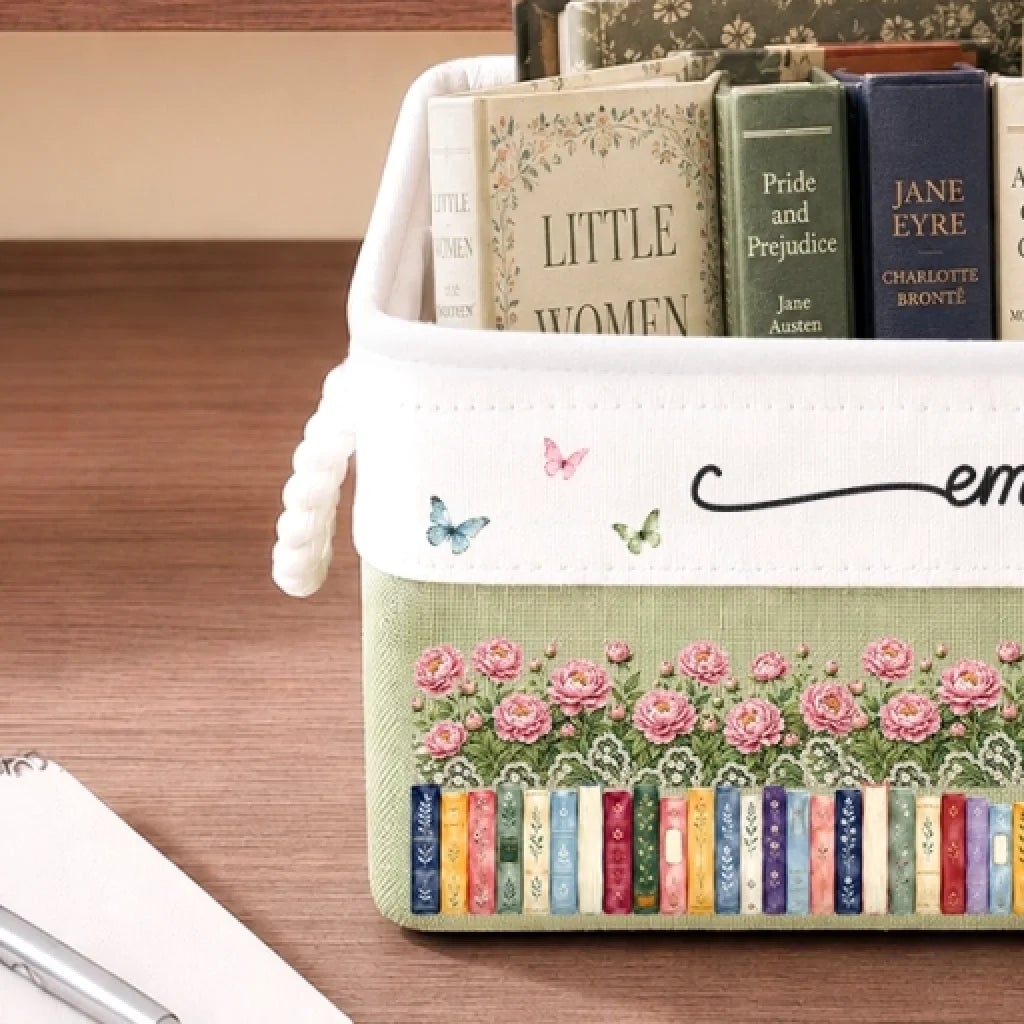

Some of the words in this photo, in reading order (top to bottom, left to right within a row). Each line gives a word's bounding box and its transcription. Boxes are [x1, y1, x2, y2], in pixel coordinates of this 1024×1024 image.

[762, 172, 817, 194] Pride
[892, 179, 965, 210] JANE
[771, 200, 810, 225] and
[542, 204, 677, 268] LITTLE
[892, 213, 967, 237] EYRE
[747, 234, 838, 262] Prejudice
[881, 267, 979, 286] CHARLOTTE
[776, 294, 811, 315] Jane
[768, 319, 822, 335] Austen
